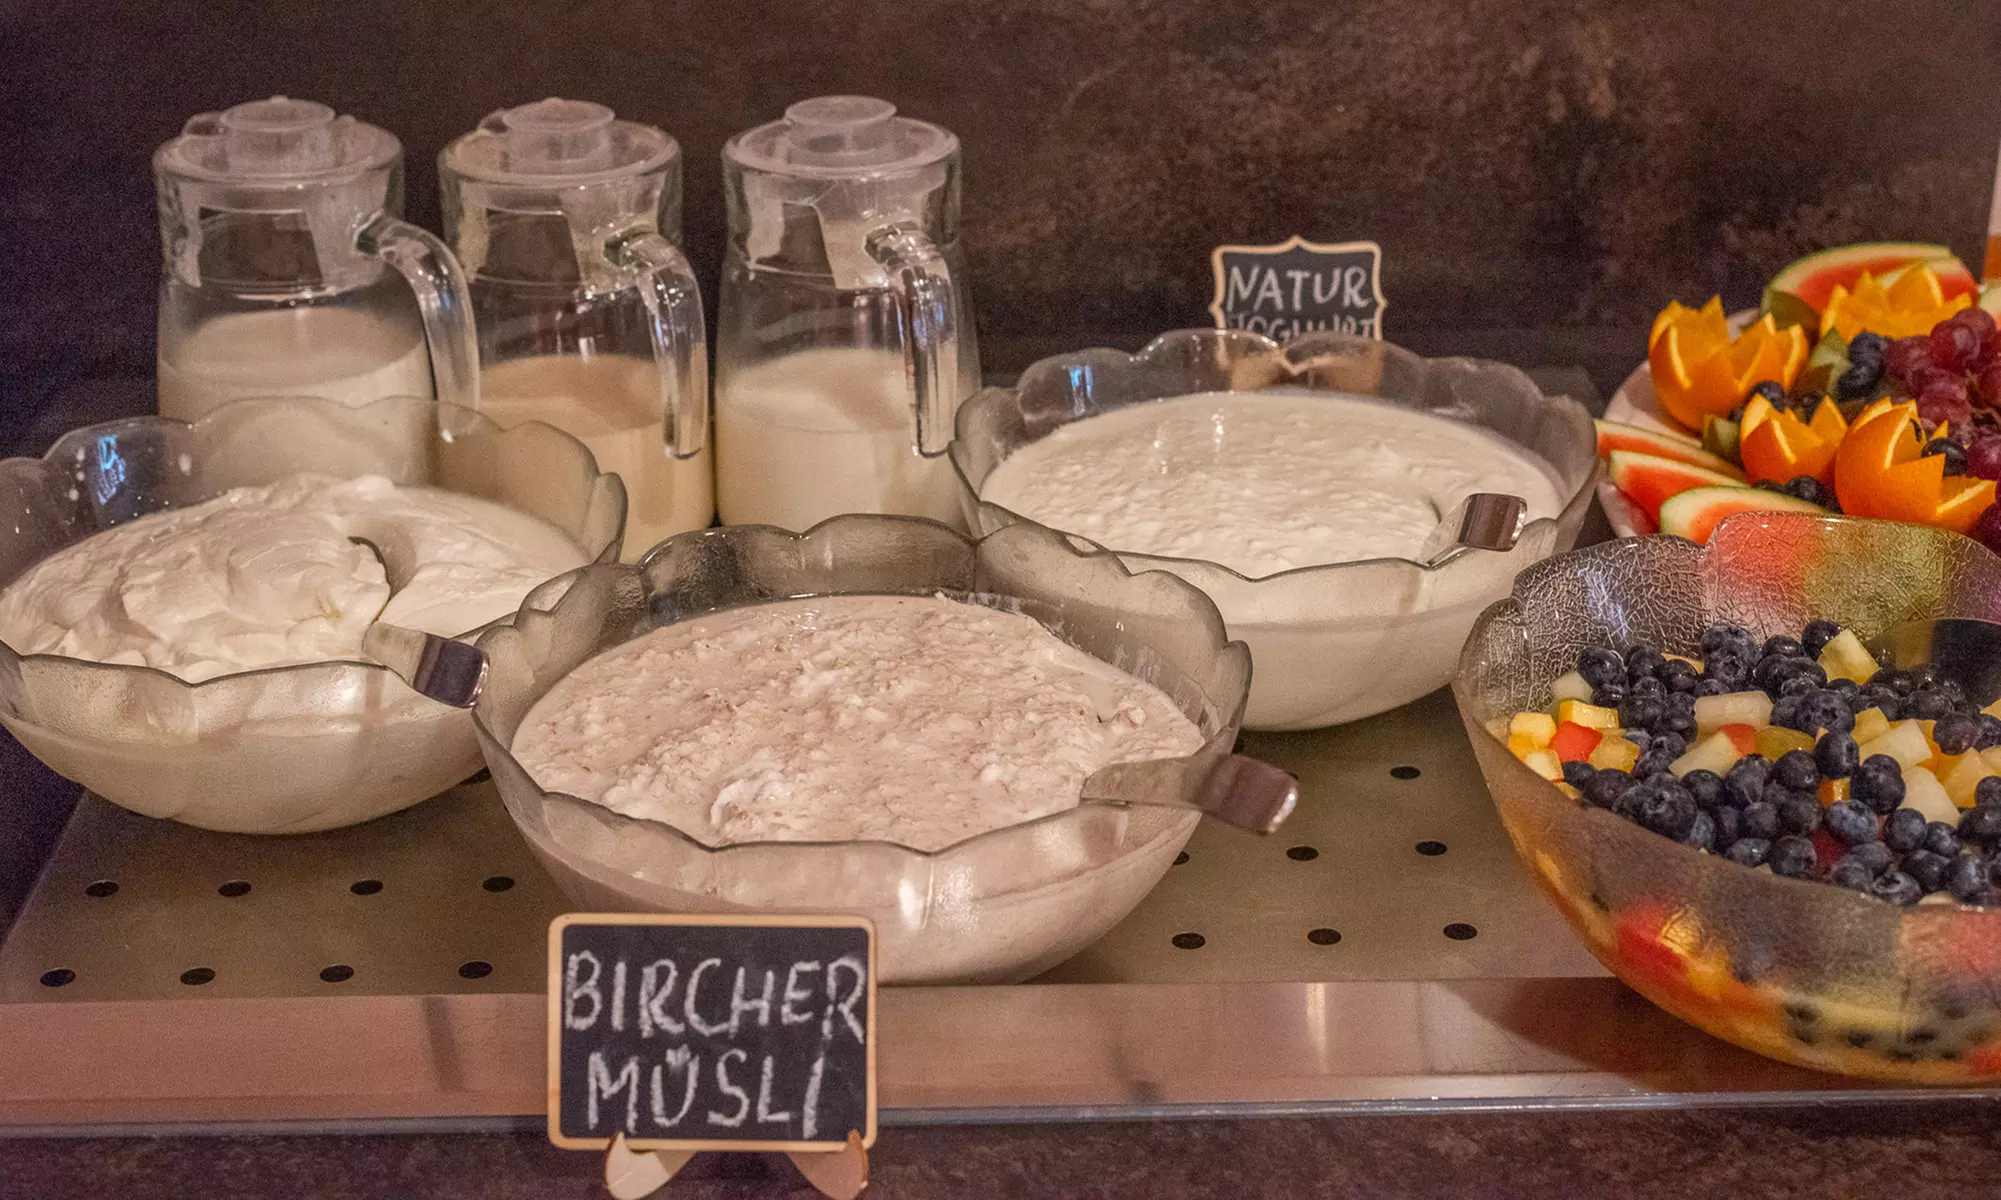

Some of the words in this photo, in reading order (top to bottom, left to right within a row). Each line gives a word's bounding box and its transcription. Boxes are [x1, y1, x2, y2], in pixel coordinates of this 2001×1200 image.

[1226, 264, 1369, 312] NATUR
[565, 950, 865, 1044] BIRCHER
[588, 1044, 824, 1139] MÜSLI
